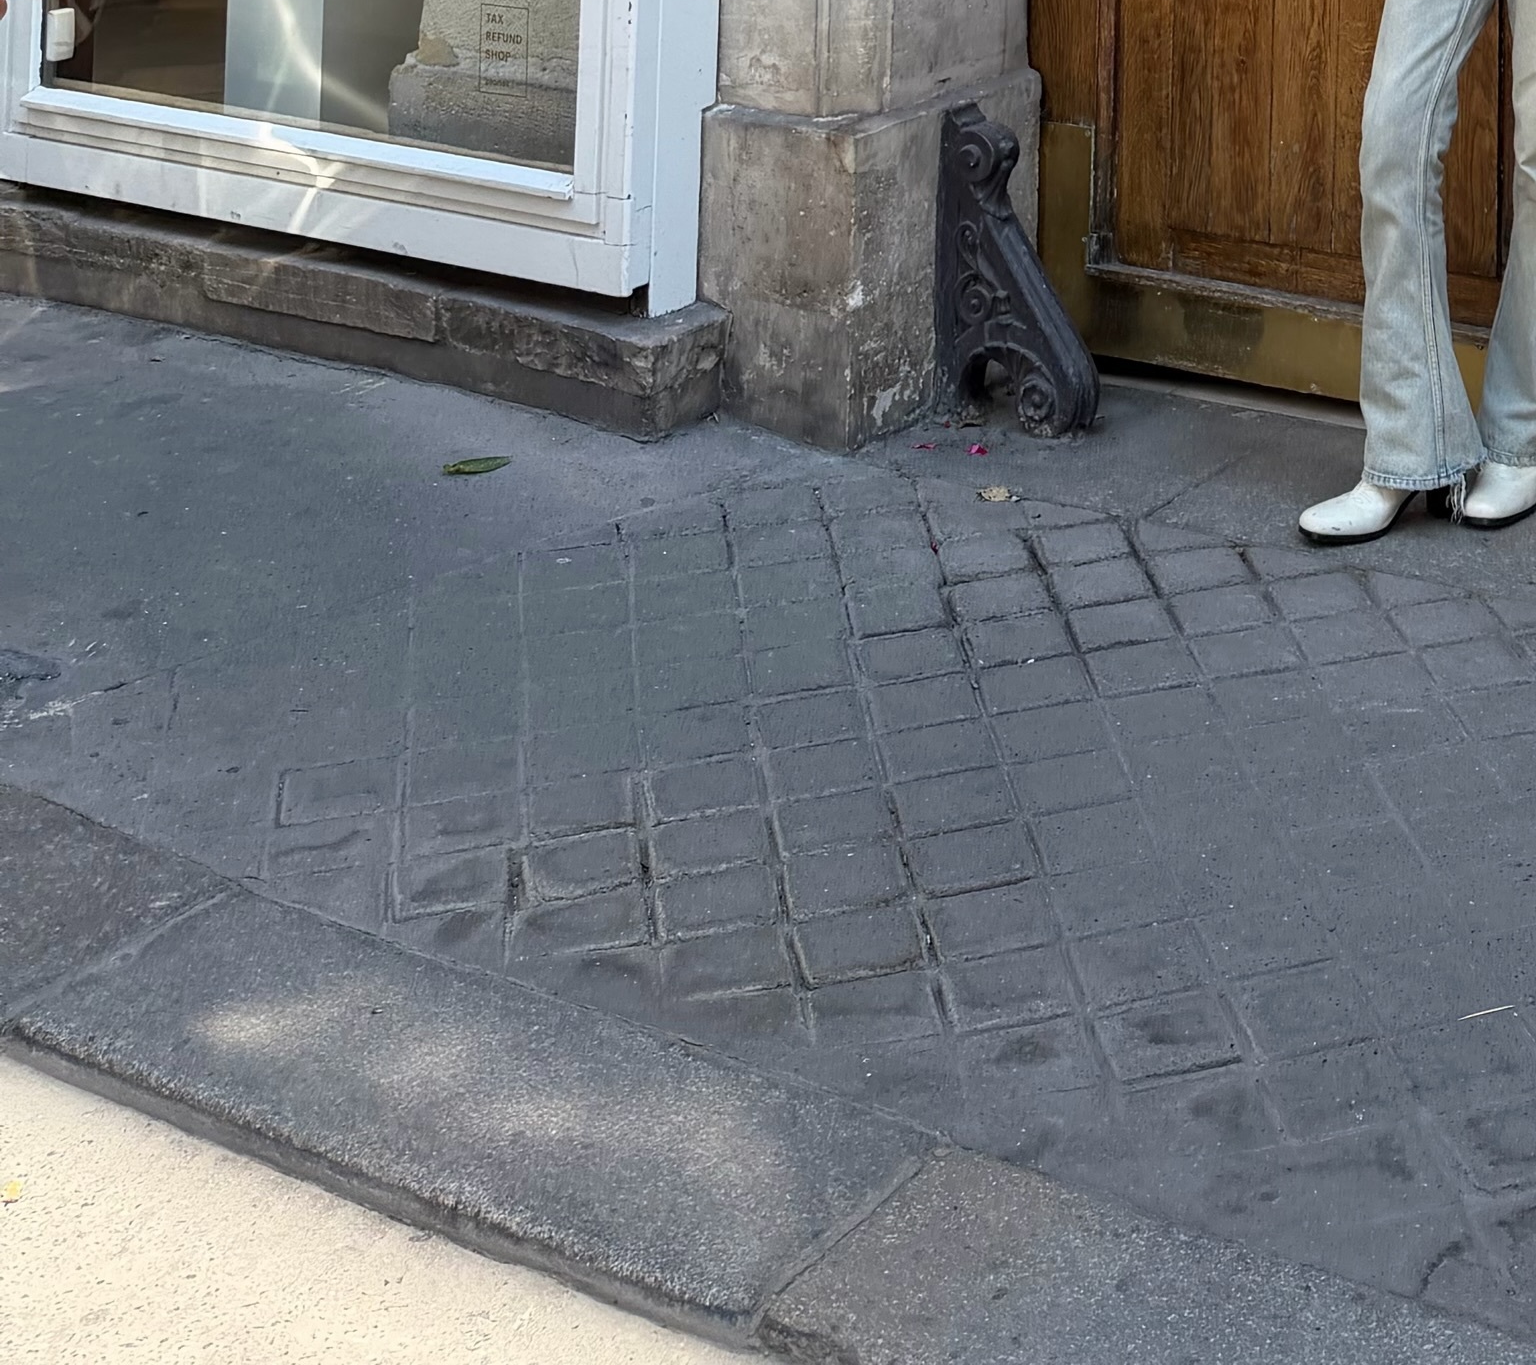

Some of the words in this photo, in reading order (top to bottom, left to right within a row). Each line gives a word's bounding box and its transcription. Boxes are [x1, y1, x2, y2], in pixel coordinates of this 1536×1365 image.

[486, 13, 504, 25] TAX
[485, 31, 523, 45] REFUND
[485, 49, 511, 62] SHOP
